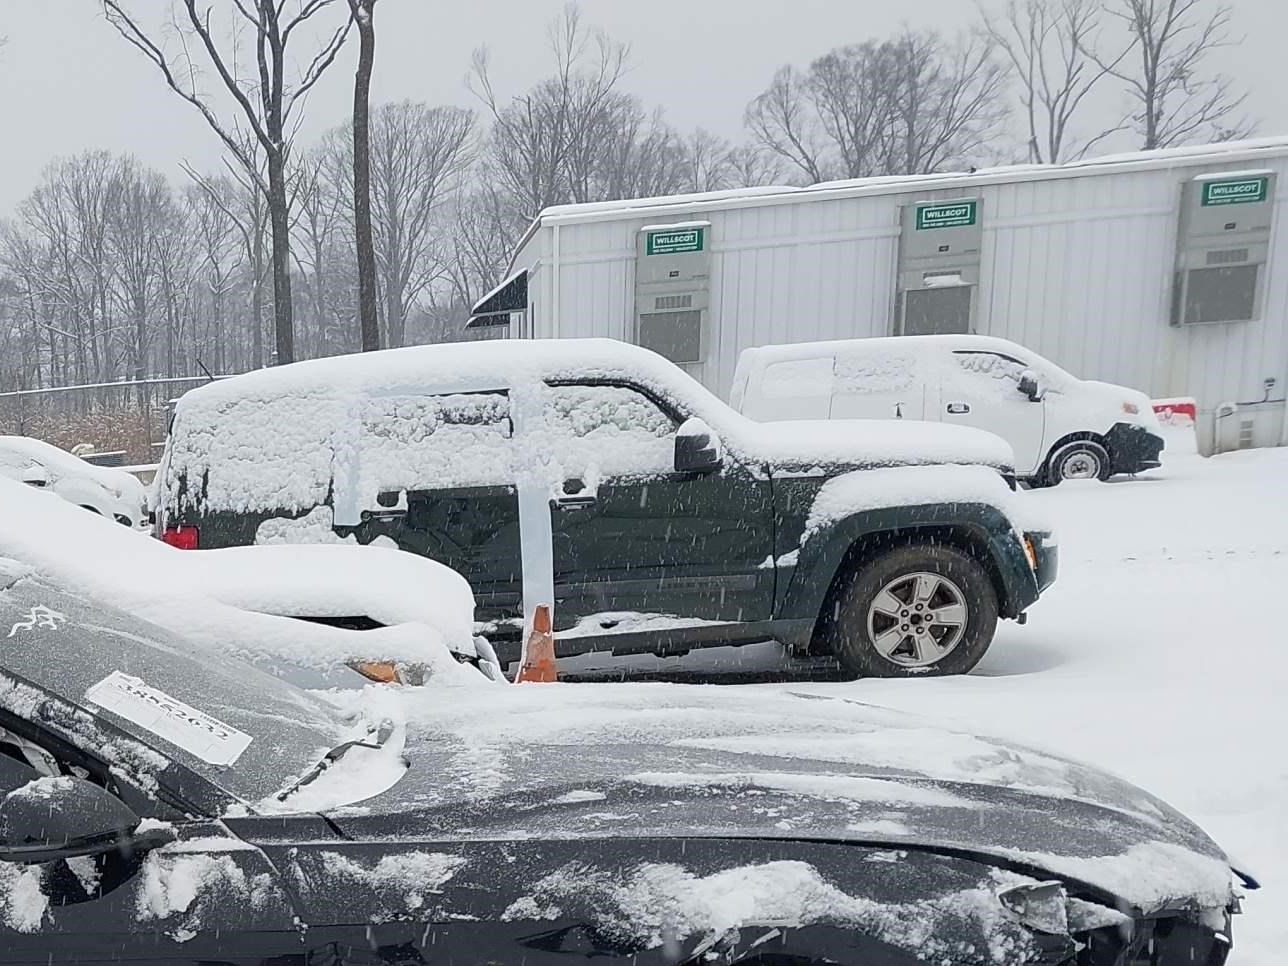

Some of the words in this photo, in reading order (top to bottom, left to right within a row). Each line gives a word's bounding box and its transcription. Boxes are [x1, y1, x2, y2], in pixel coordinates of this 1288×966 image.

[1213, 184, 1258, 195] WILLSCOT
[927, 208, 967, 219] WILLSCOT
[656, 234, 695, 244] WILLSCOT
